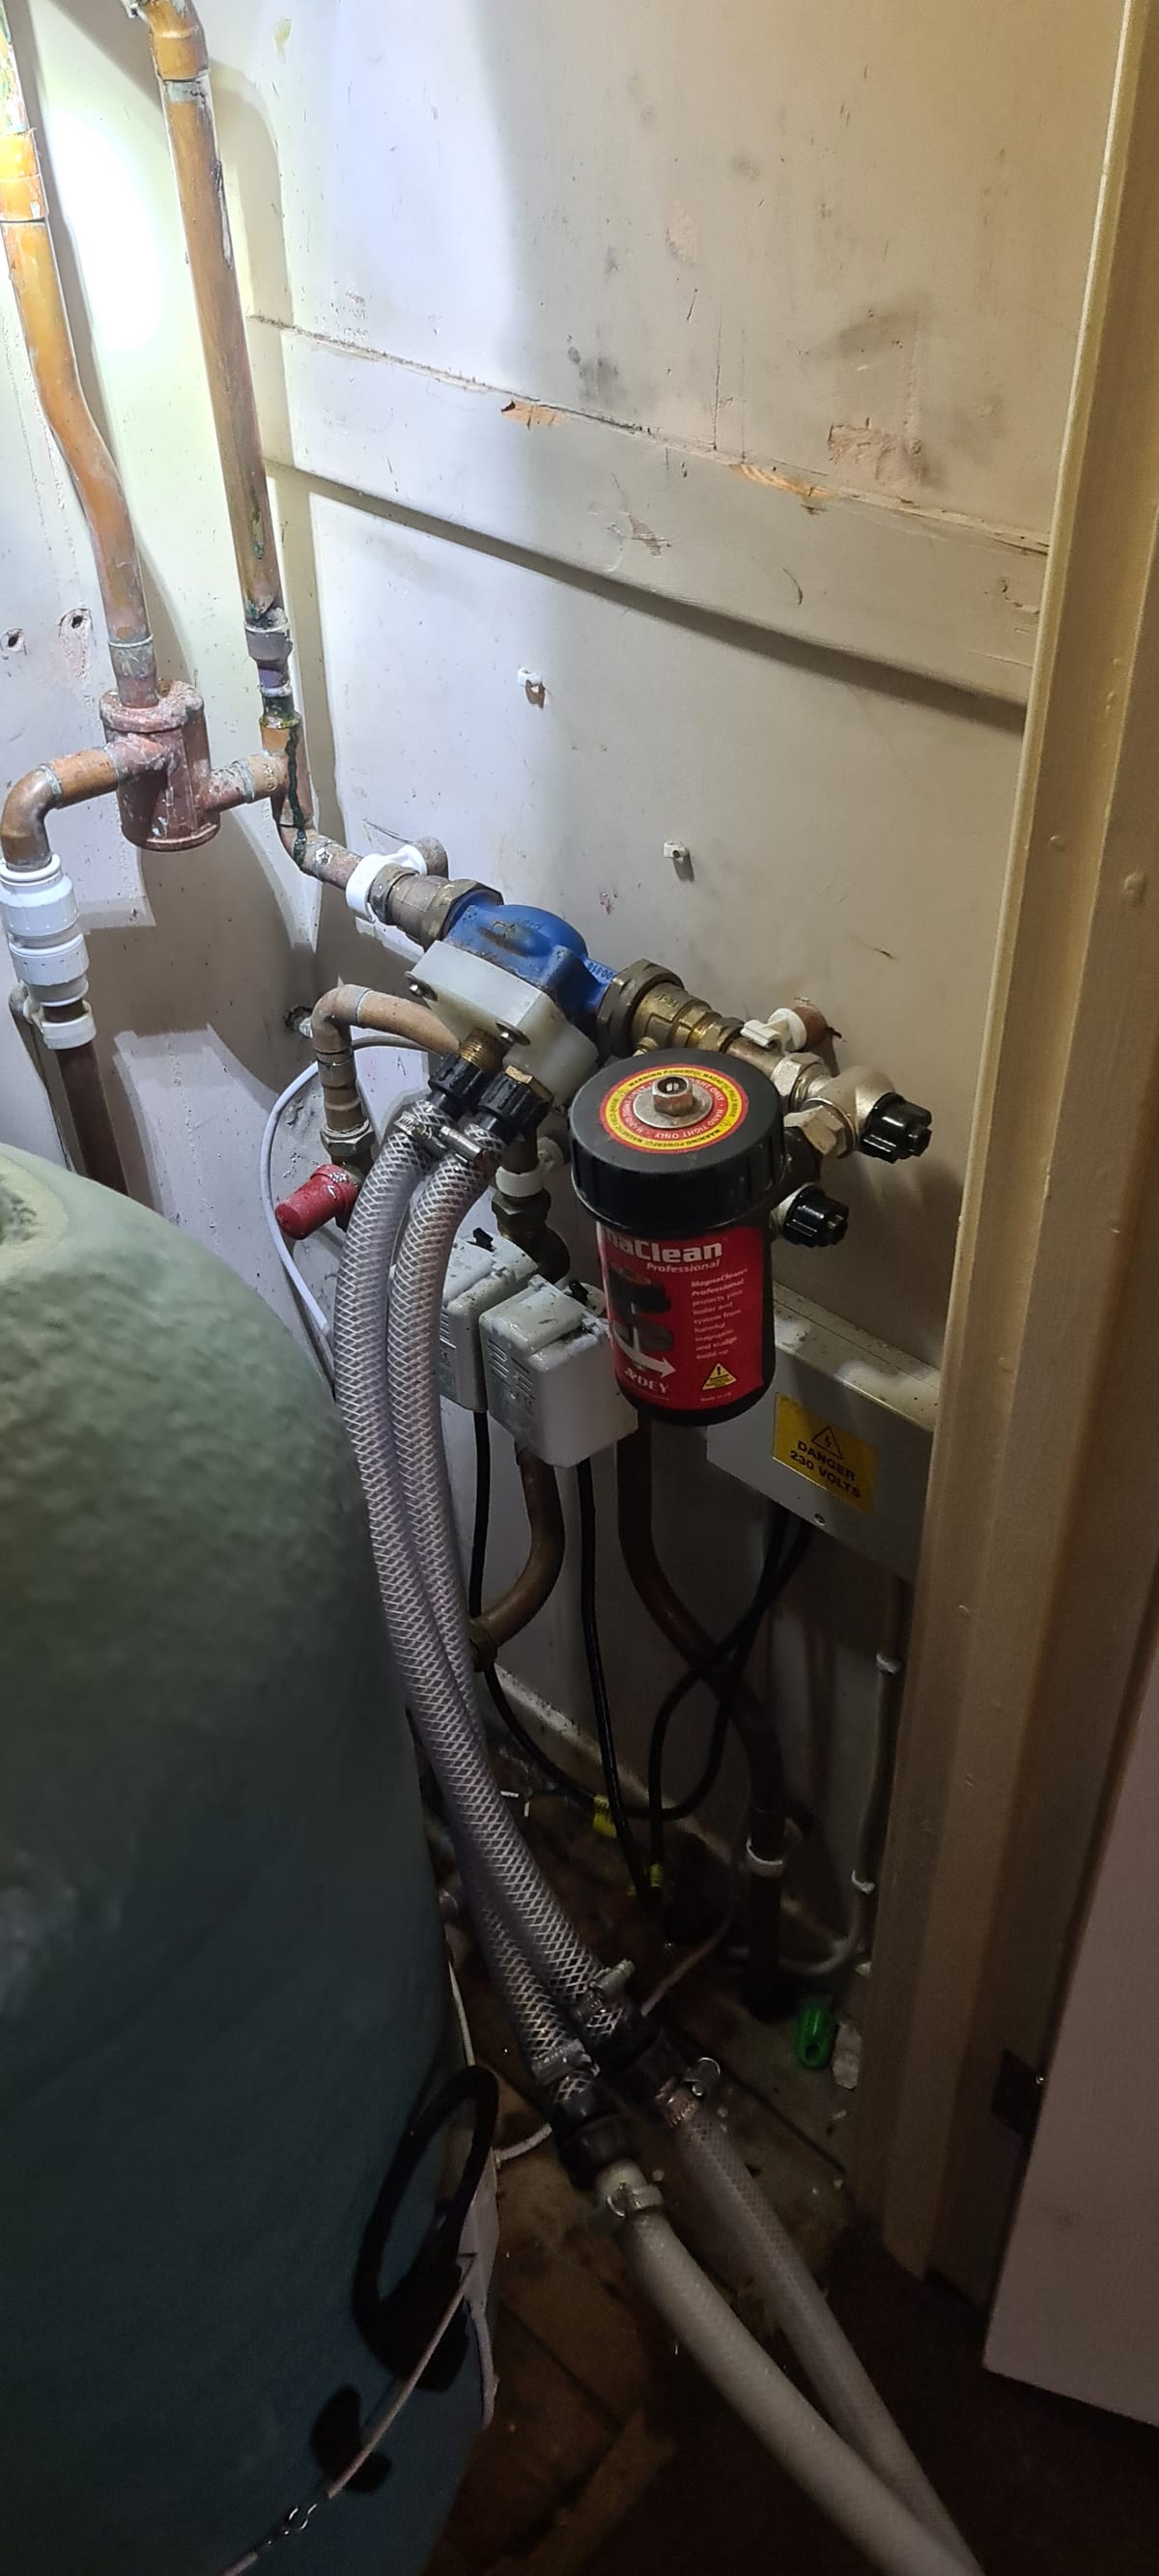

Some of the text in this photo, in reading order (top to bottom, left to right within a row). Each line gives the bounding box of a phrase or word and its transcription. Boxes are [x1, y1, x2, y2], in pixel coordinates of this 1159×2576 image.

[707, 1109, 724, 1126] HAND
[683, 1124, 710, 1138] TIGHT
[646, 1260, 720, 1273] Professional
[692, 1278, 744, 1296] Professional
[798, 1440, 856, 1481] DANGER
[790, 1450, 861, 1498] 230 VOLTS
